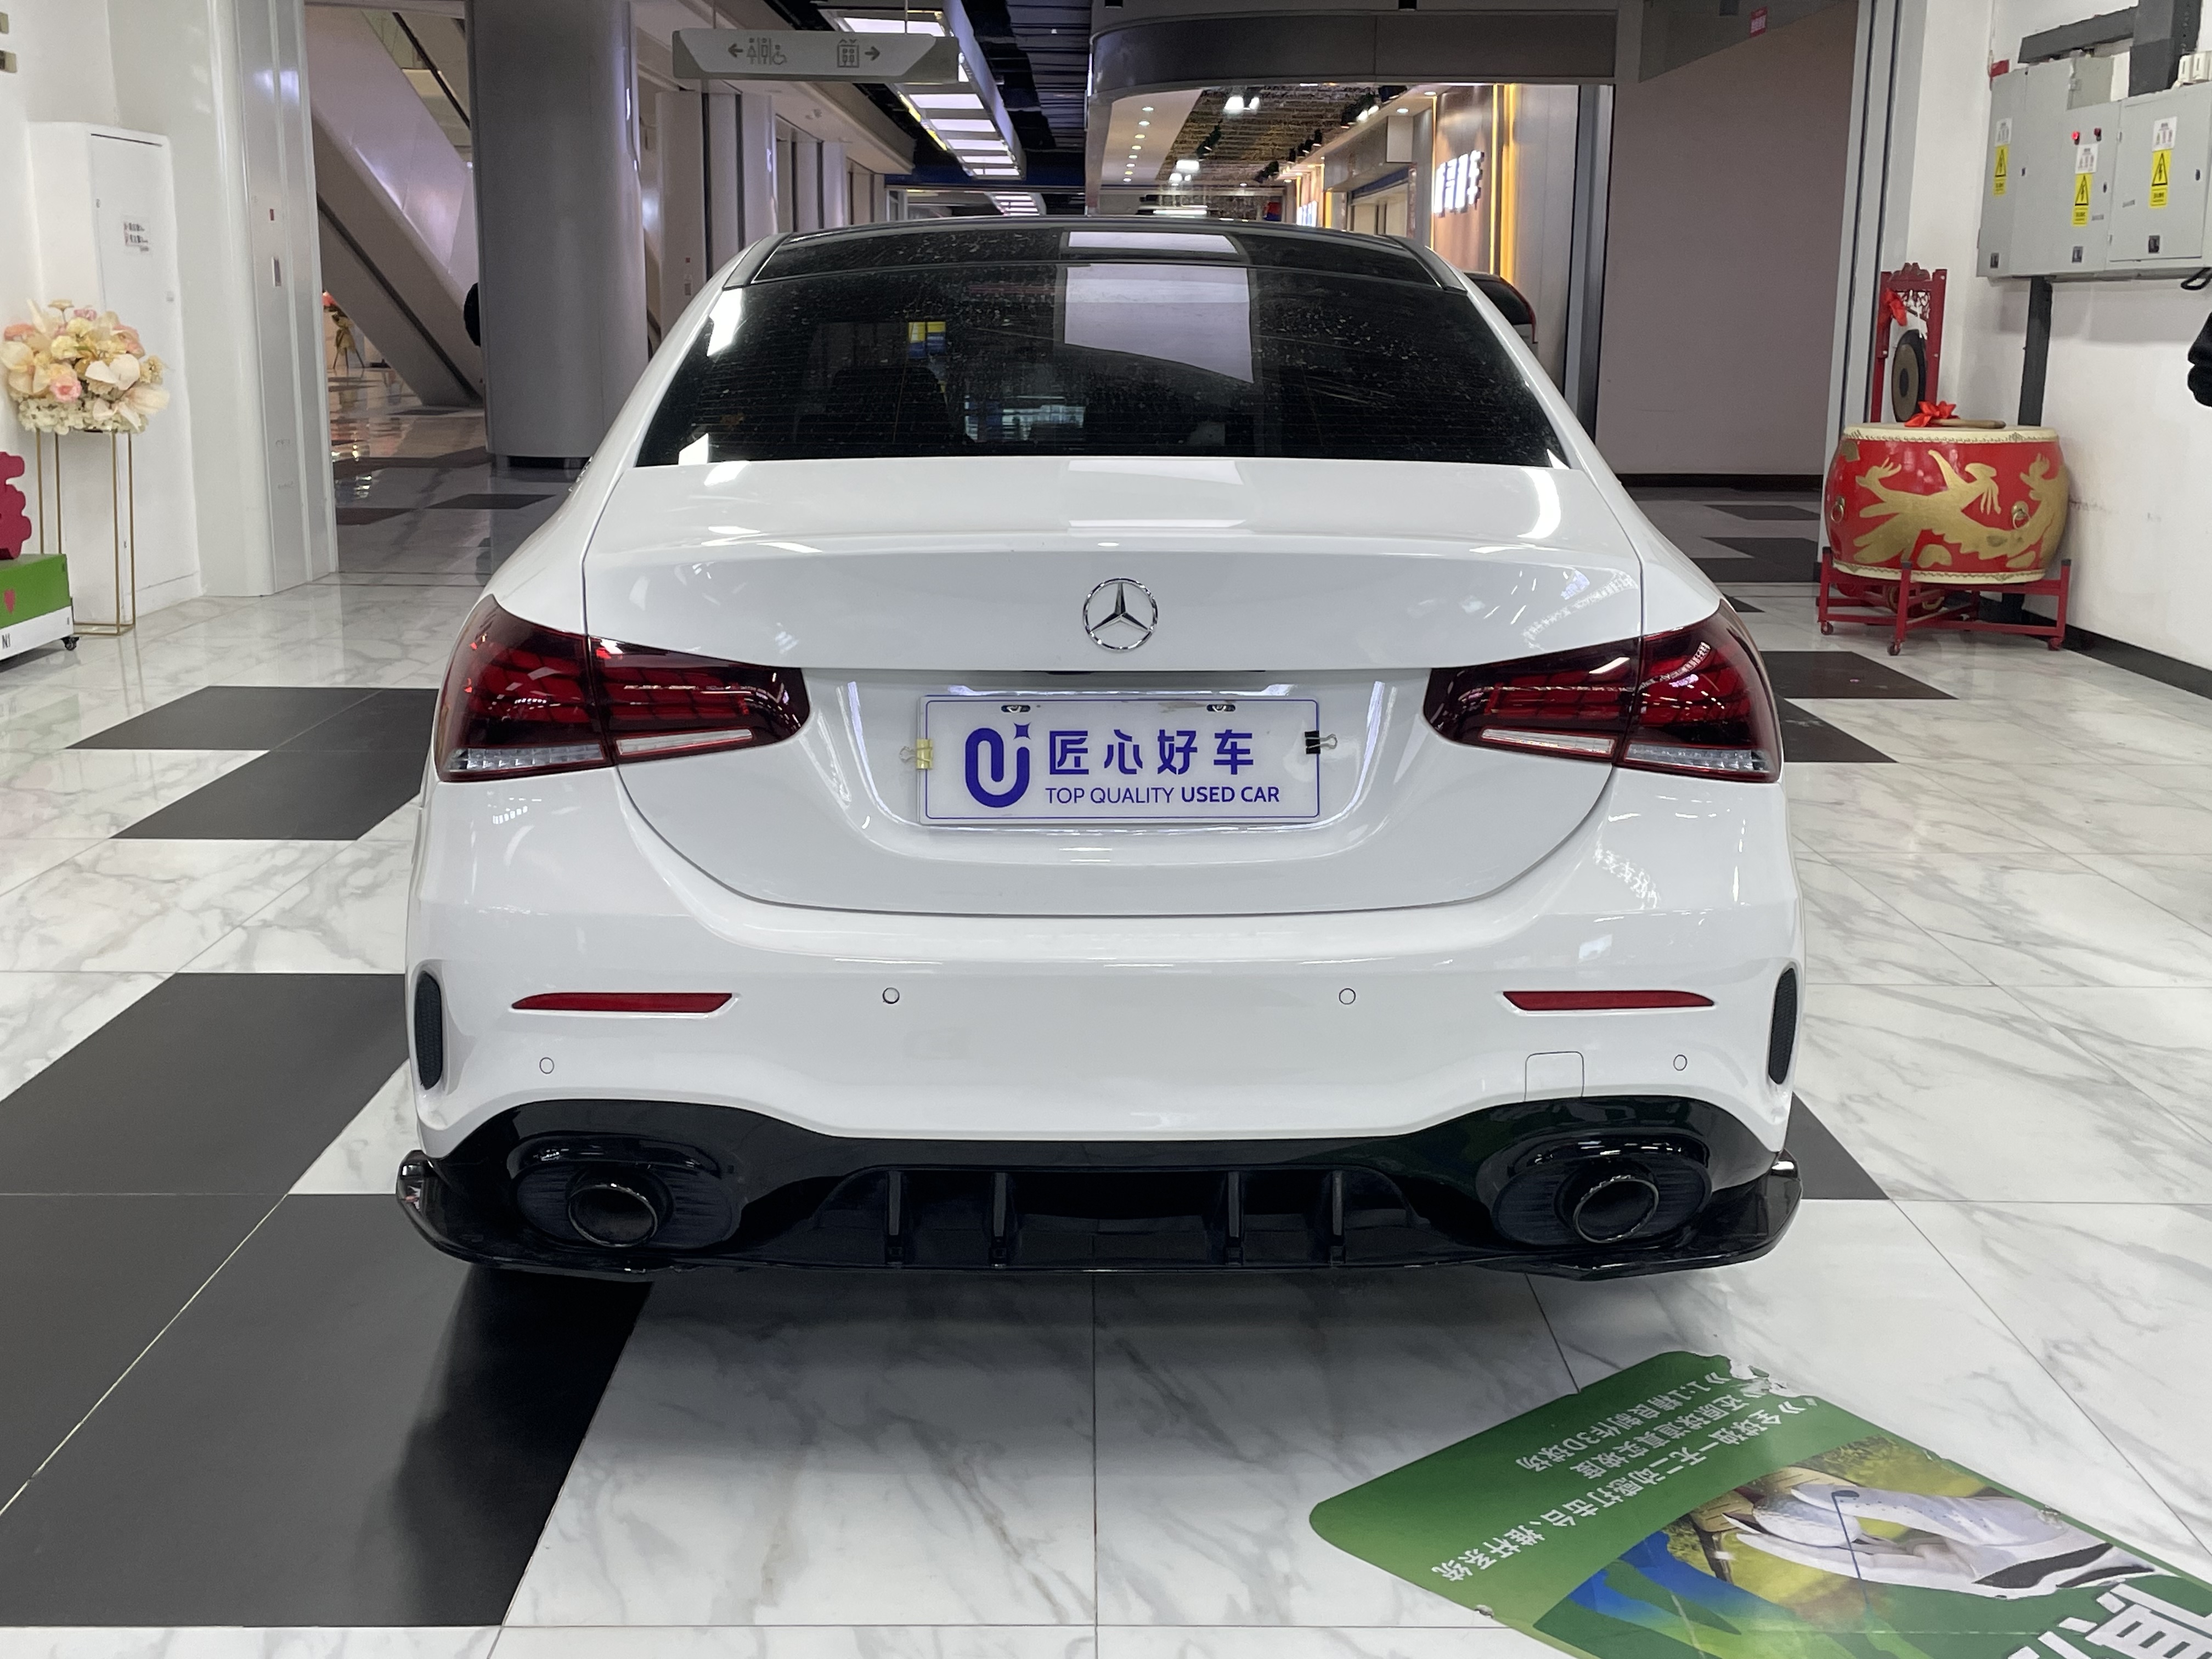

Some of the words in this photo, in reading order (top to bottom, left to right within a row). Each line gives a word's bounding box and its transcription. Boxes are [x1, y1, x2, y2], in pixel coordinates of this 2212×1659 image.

[1049, 729, 1254, 775] 匠心好车
[1045, 787, 1085, 804] TOP
[1090, 787, 1175, 805] QUALITY
[1181, 786, 1235, 803] USED
[1240, 786, 1279, 803] CAR
